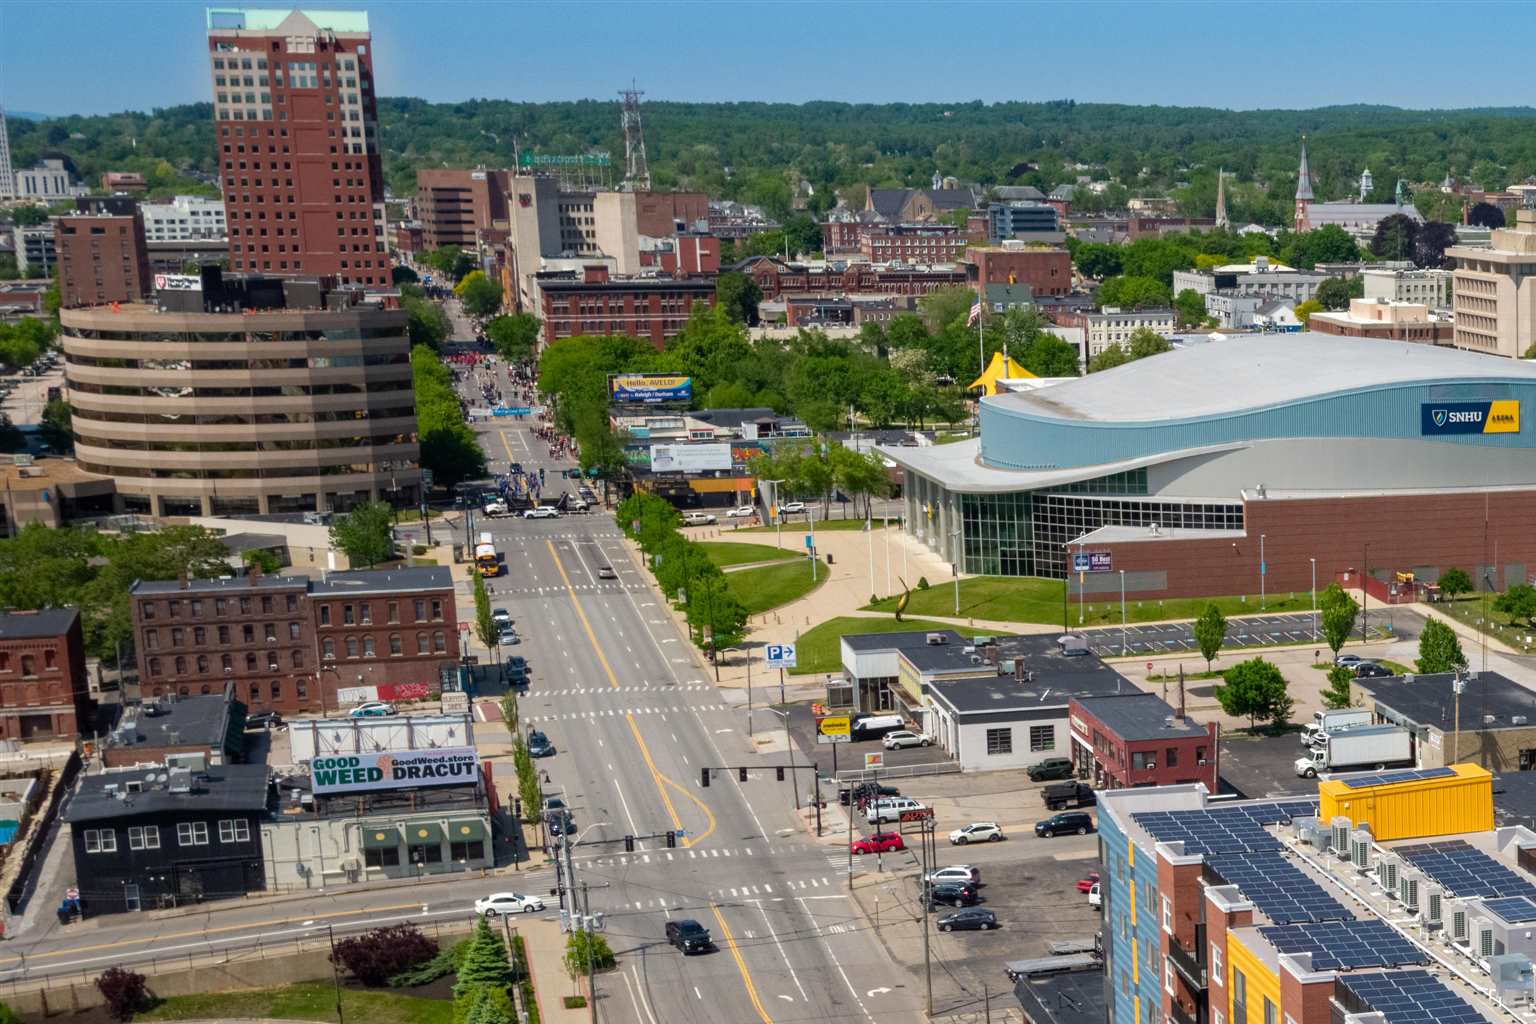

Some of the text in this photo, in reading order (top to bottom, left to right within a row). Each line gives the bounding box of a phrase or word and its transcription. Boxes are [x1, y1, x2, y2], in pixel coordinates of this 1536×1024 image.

[1448, 411, 1482, 422] SNHU
[770, 646, 780, 659] P
[313, 756, 360, 770] GOOD
[391, 755, 474, 767] GoodWeed.store
[314, 767, 383, 786] WEED
[393, 762, 475, 781] DRACUT
